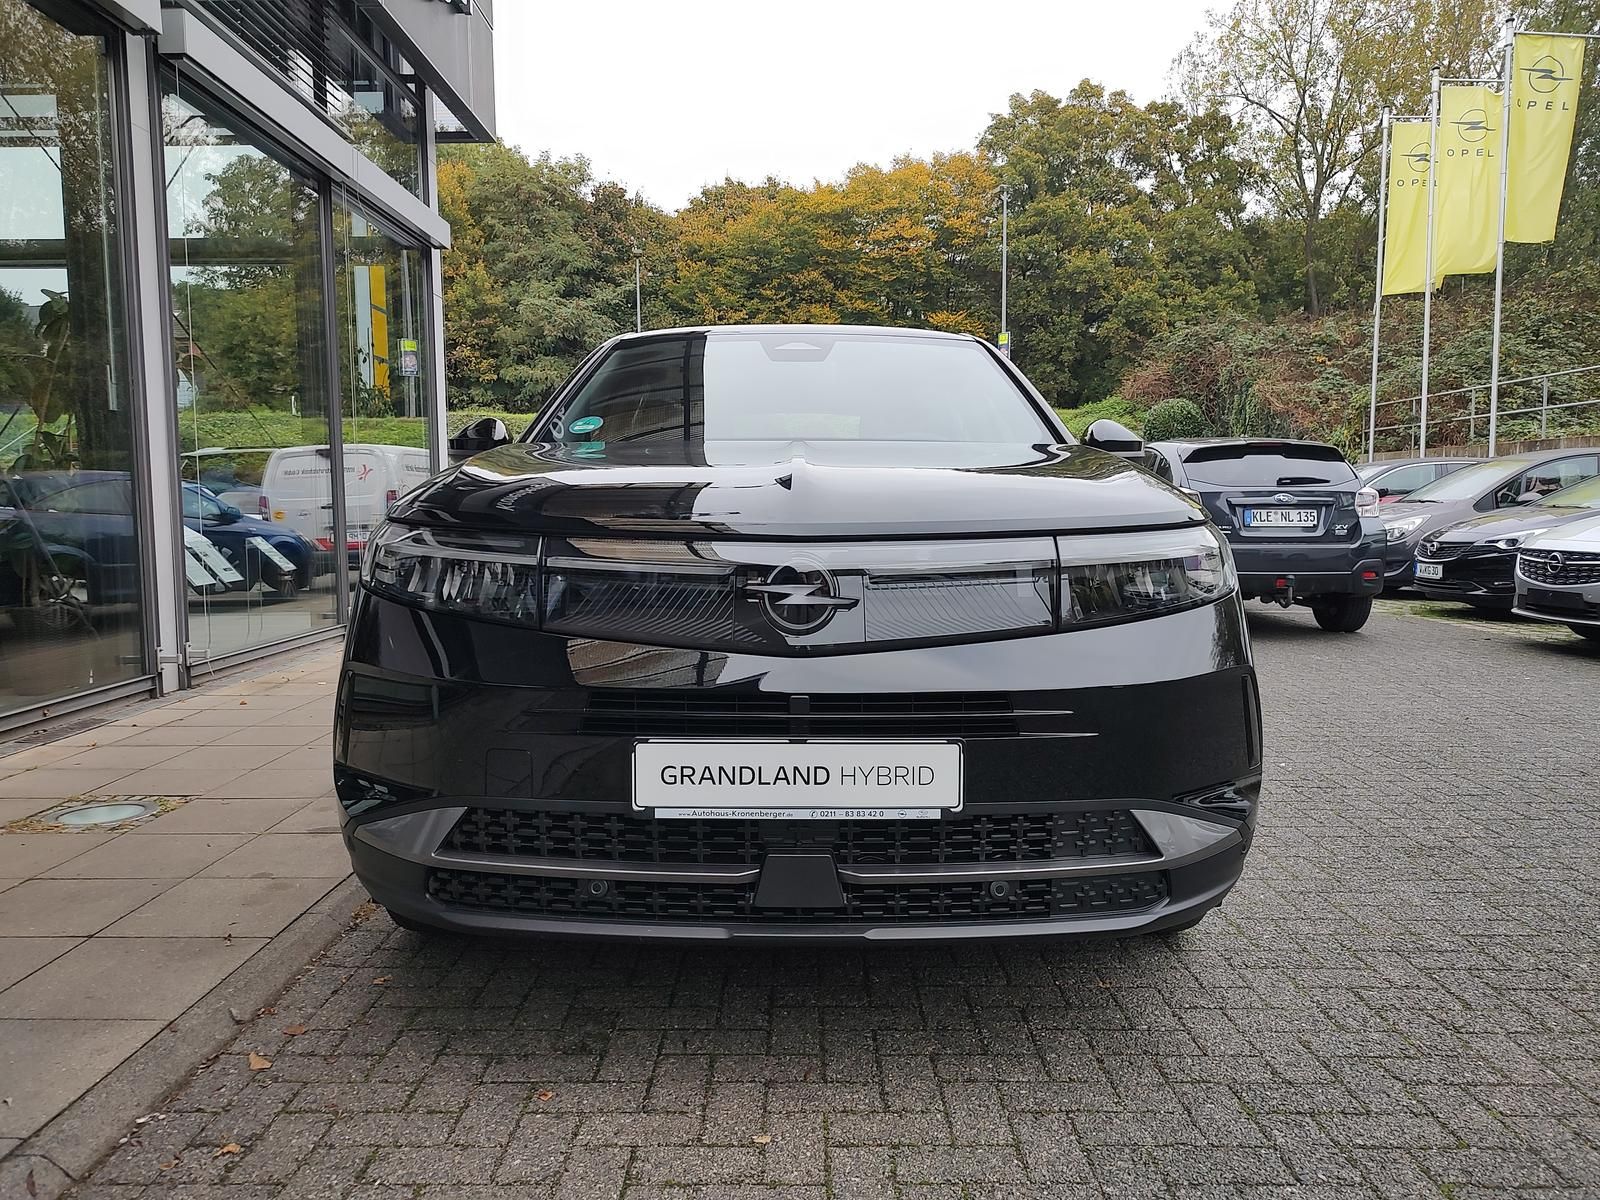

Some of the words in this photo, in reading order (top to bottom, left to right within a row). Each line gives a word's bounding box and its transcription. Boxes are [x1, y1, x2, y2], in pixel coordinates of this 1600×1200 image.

[1446, 148, 1494, 157] OPEL
[1252, 511, 1272, 522] KLE
[1280, 511, 1294, 522] NL
[1296, 511, 1316, 522] 135
[660, 765, 830, 786] GRANDLAND
[840, 766, 934, 786] HYBRID
